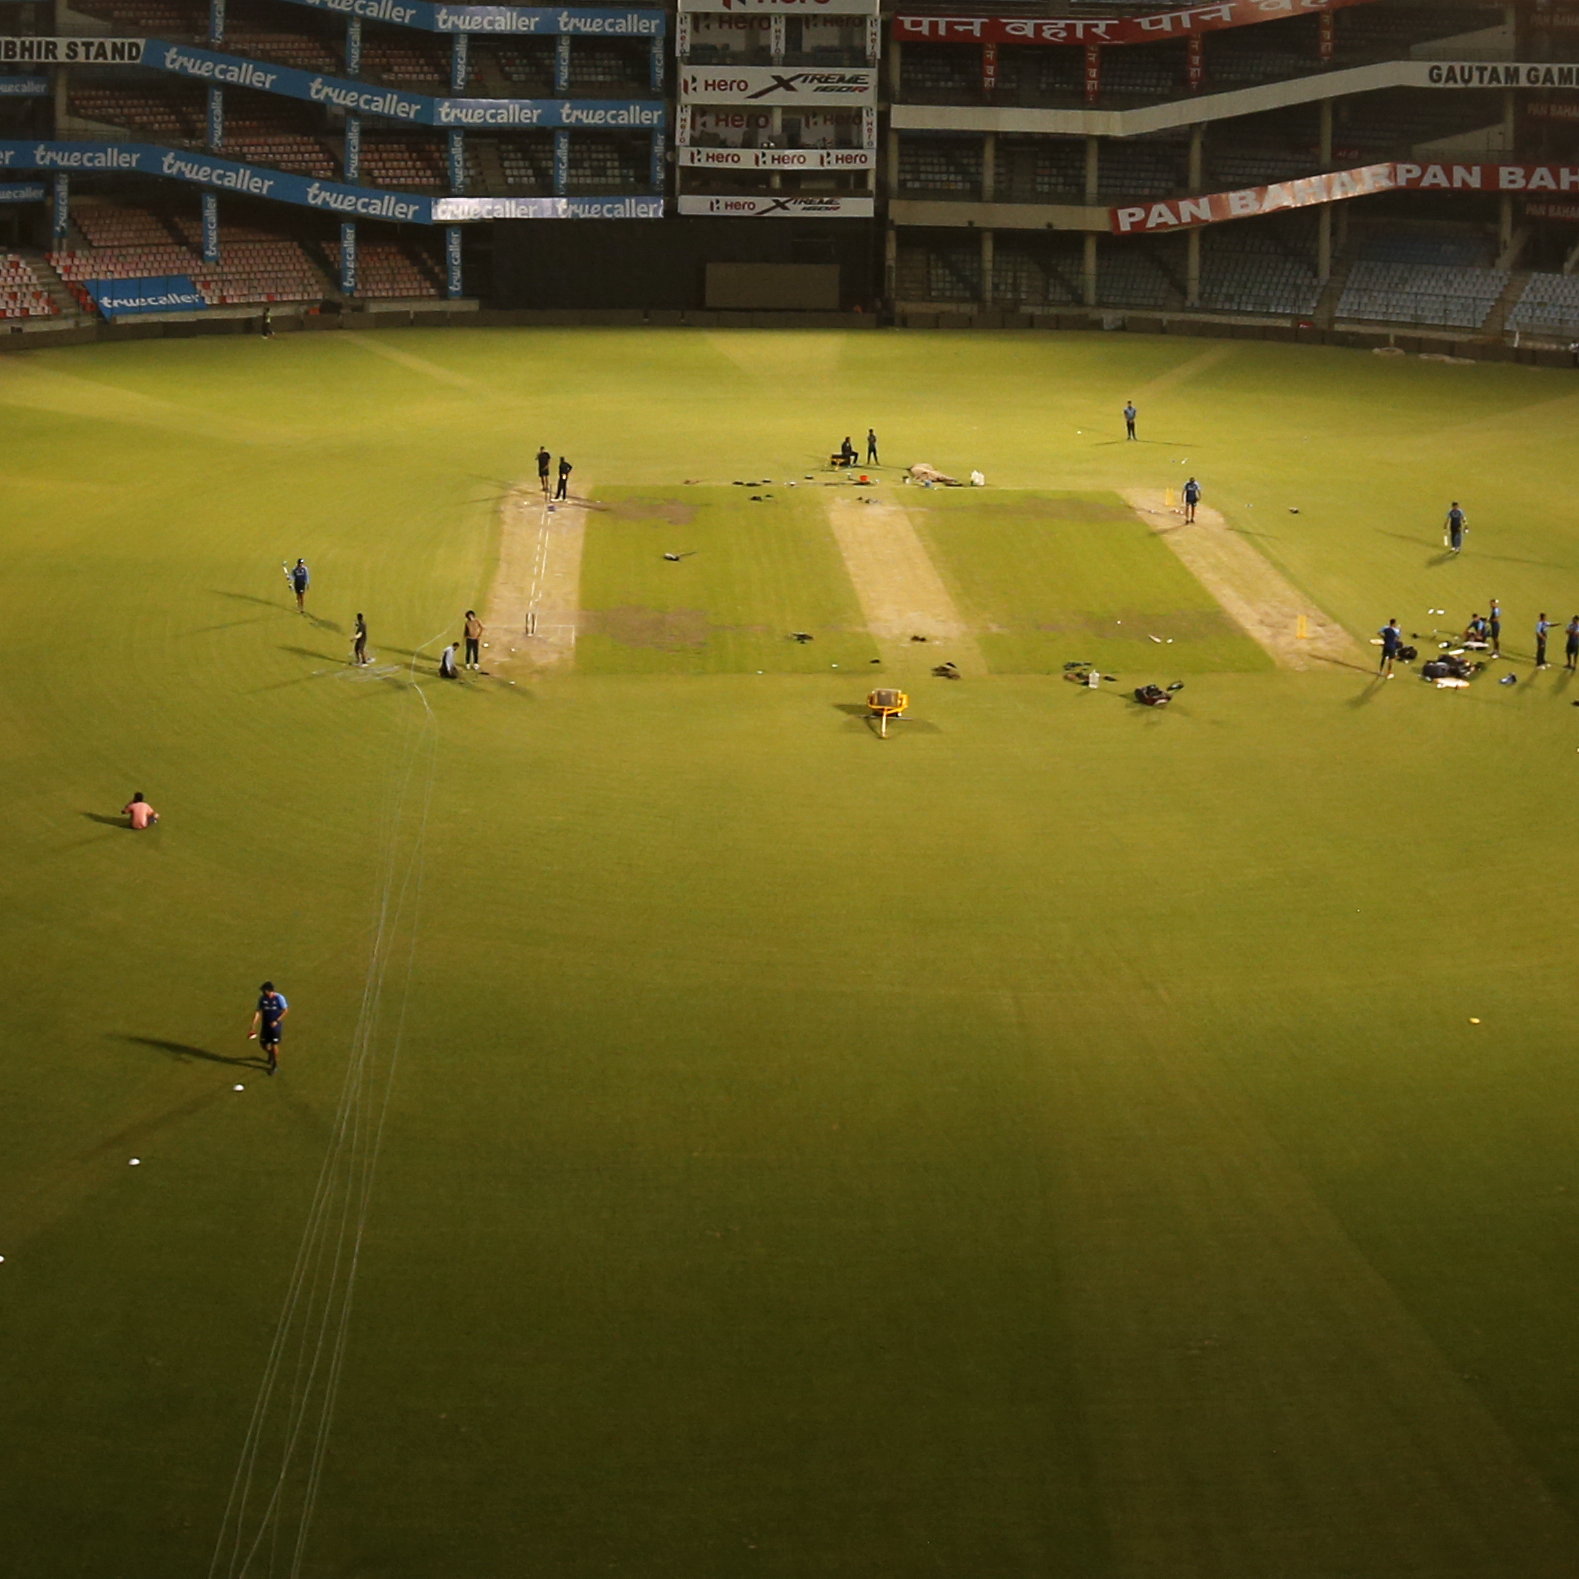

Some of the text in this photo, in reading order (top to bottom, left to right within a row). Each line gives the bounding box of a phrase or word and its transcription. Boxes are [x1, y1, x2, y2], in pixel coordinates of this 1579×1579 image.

[436, 8, 540, 31] truecaller
[558, 11, 661, 33] truecaller
[897, 16, 1120, 42] पान बहार
[1133, 2, 1237, 31] पान
[65, 40, 142, 62] STAND
[164, 47, 277, 89] truecaller
[1429, 66, 1520, 85] GAUTAM
[309, 77, 421, 120] truecaller
[745, 73, 870, 100] XTREME
[439, 101, 543, 123] truecaller
[559, 103, 662, 125] truecaller
[33, 145, 141, 168] truecaller
[161, 151, 274, 195] truecaller
[1396, 164, 1482, 188] PAN
[306, 182, 419, 221] truecaller
[437, 198, 539, 220] truecaller
[555, 197, 659, 219] truecaller
[1117, 166, 1394, 231] PAN BAHAR
[205, 196, 218, 258] truecaller
[343, 228, 356, 289] truecaller
[449, 231, 462, 292] truecaller
[100, 290, 203, 309] truecaller
